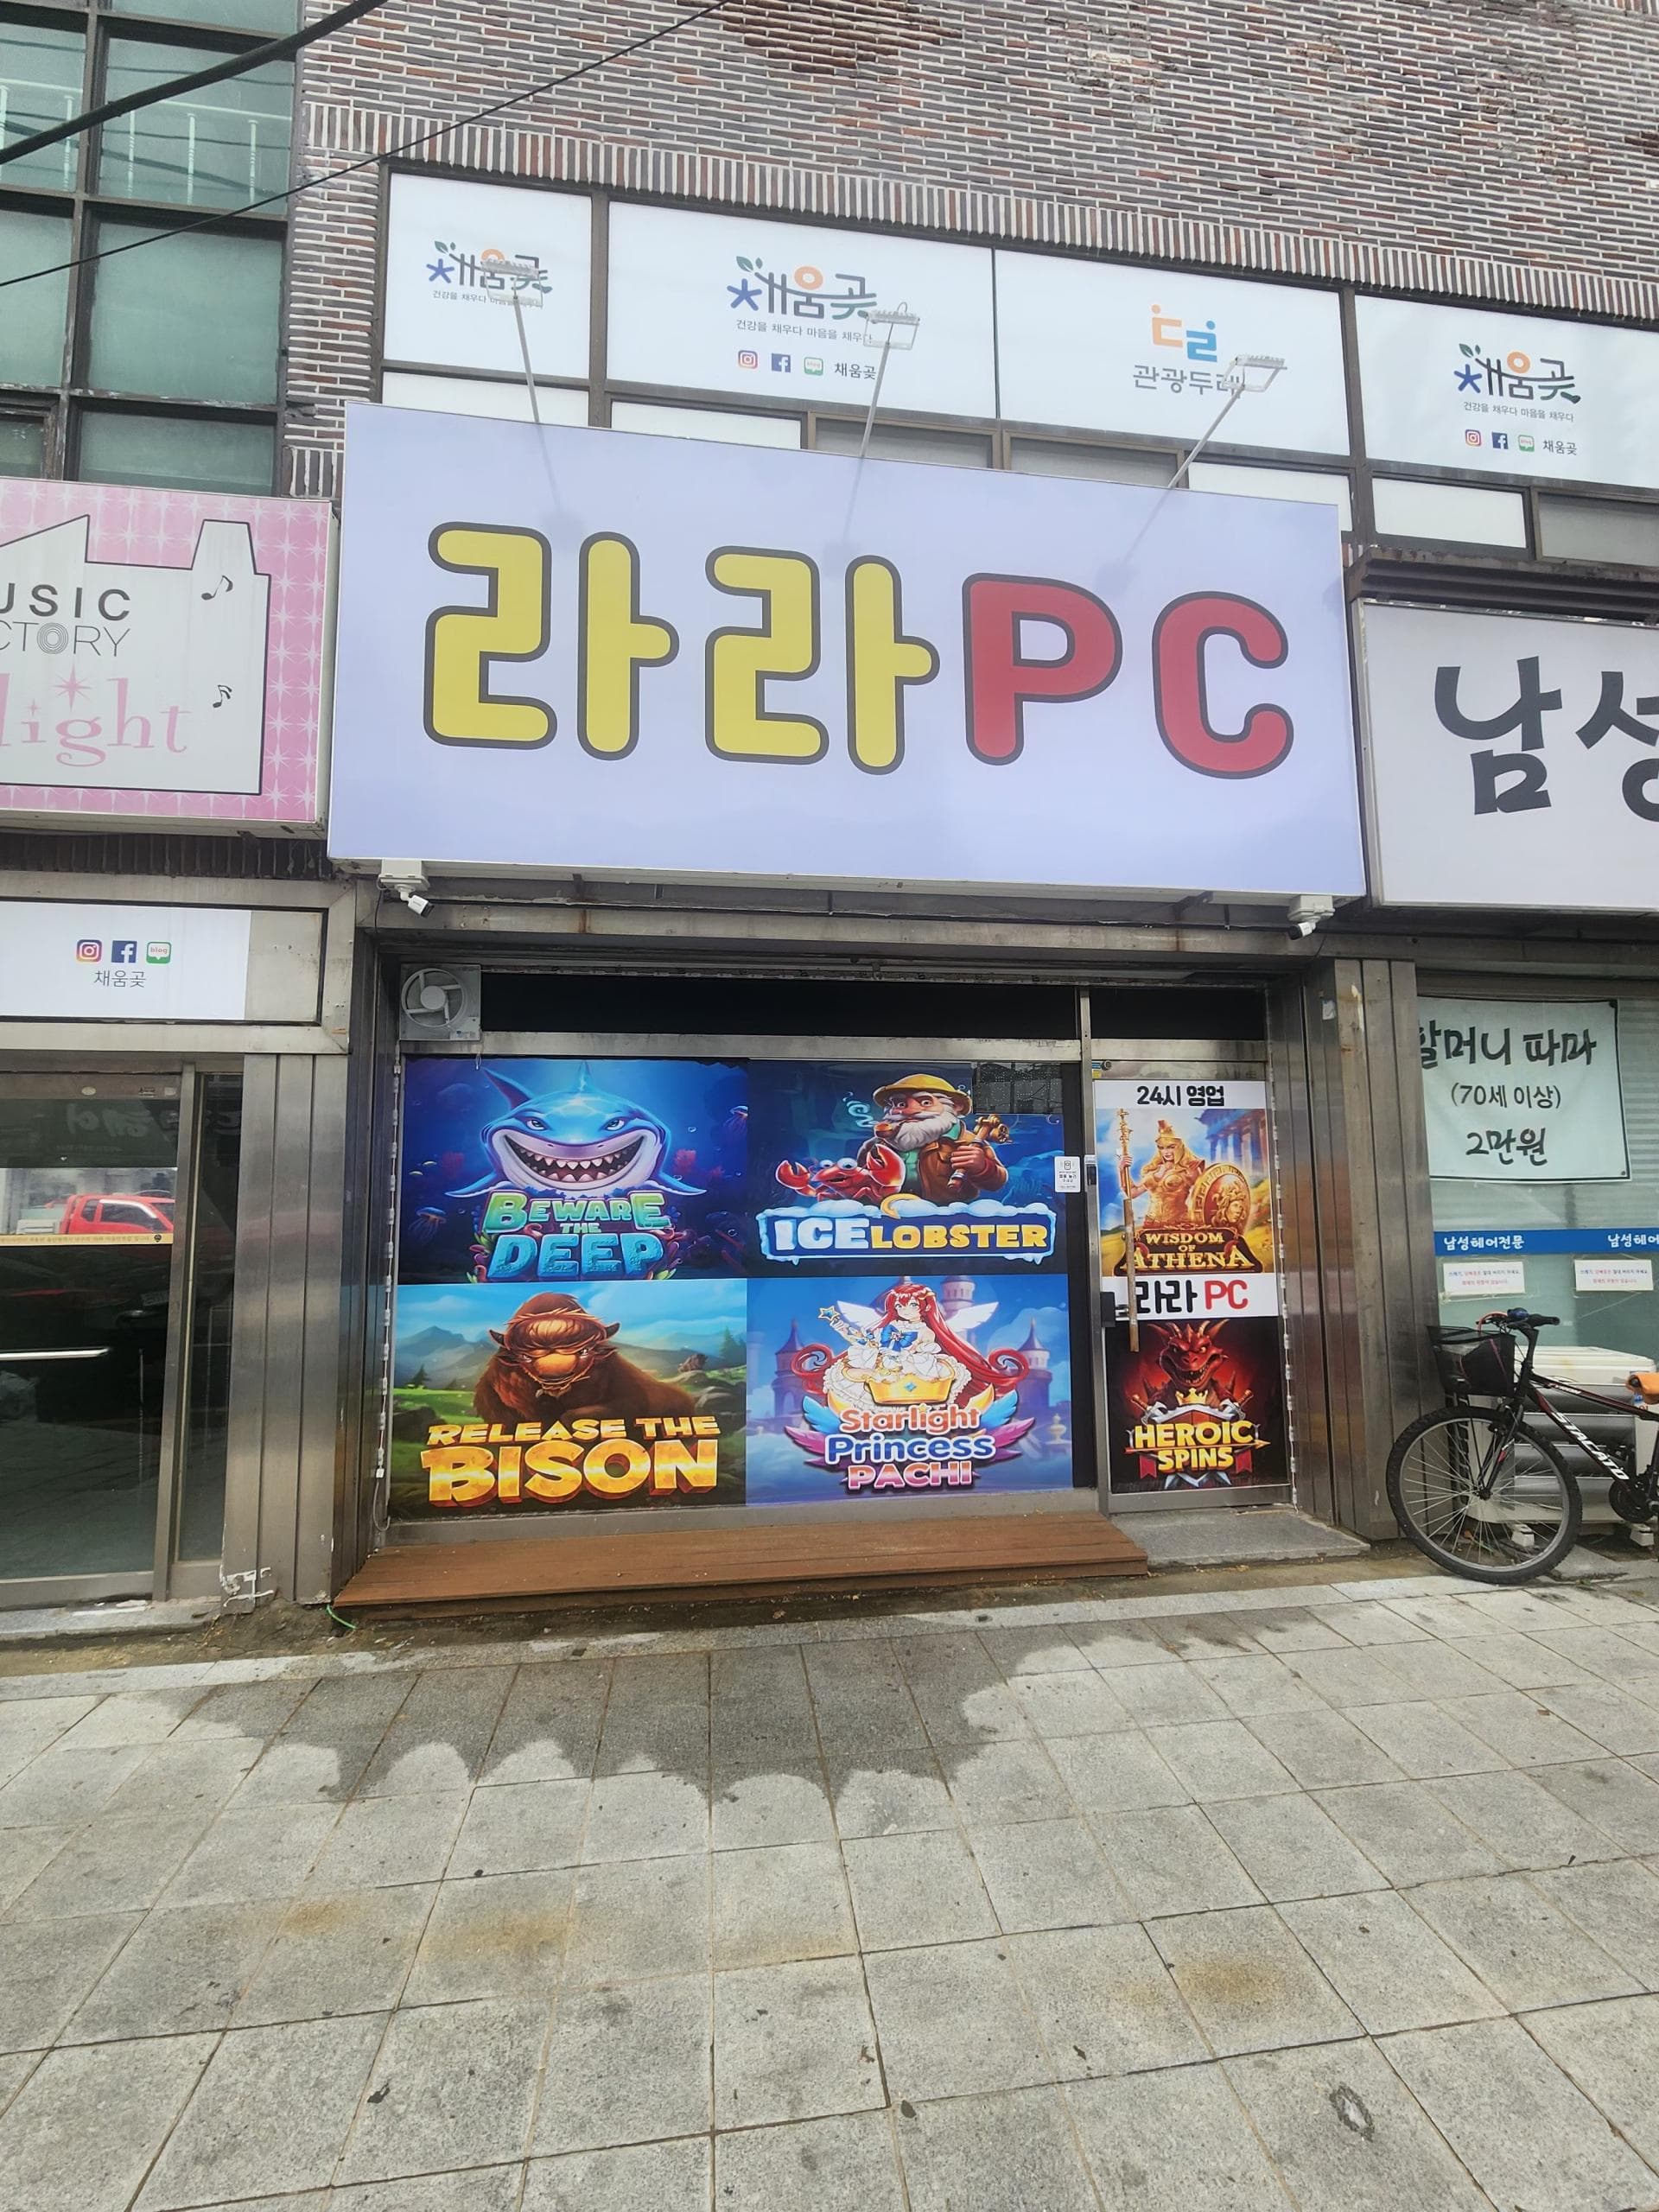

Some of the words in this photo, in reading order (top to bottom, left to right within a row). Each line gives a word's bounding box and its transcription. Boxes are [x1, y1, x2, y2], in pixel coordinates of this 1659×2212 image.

[736, 319, 767, 333] 건강을
[772, 322, 802, 336] 채우다
[806, 327, 837, 340] 마음을
[834, 362, 877, 380] 채움곶
[1453, 350, 1582, 404] 채움곶
[1464, 401, 1489, 412] 건강을
[1492, 404, 1517, 416] 채우다
[1521, 408, 1546, 419] 마음을
[1549, 411, 1574, 423] 채우다
[1542, 439, 1577, 455] 채움곶
[93, 969, 146, 988] 채움곶
[1522, 1028, 1597, 1067] 파마
[1136, 1085, 1181, 1106] 24시
[1186, 1085, 1225, 1107] 영업
[1451, 1082, 1507, 1109] (70세
[1513, 1084, 1561, 1109] 이상)
[1465, 1127, 1548, 1166] 2만원
[484, 1190, 673, 1234] BEWARE
[560, 1222, 602, 1235] THE
[774, 1217, 869, 1251] ICE
[870, 1224, 1048, 1249] LOBSTER
[1145, 1231, 1225, 1244] WISDOM
[486, 1233, 664, 1279] DEEP
[1179, 1244, 1196, 1253] OF
[1443, 1234, 1525, 1251] 남성헤어전문
[1120, 1247, 1255, 1270] ATHENA
[1204, 1279, 1249, 1311] PC
[427, 1418, 627, 1446] RELEASE
[635, 1415, 721, 1440] THE
[840, 1404, 981, 1435] Starlight
[1135, 1421, 1255, 1448] HEROIC
[824, 1432, 996, 1465] Princess
[1158, 1446, 1234, 1471] SPINS
[420, 1439, 720, 1508] BISON
[846, 1460, 973, 1491] PACHI
